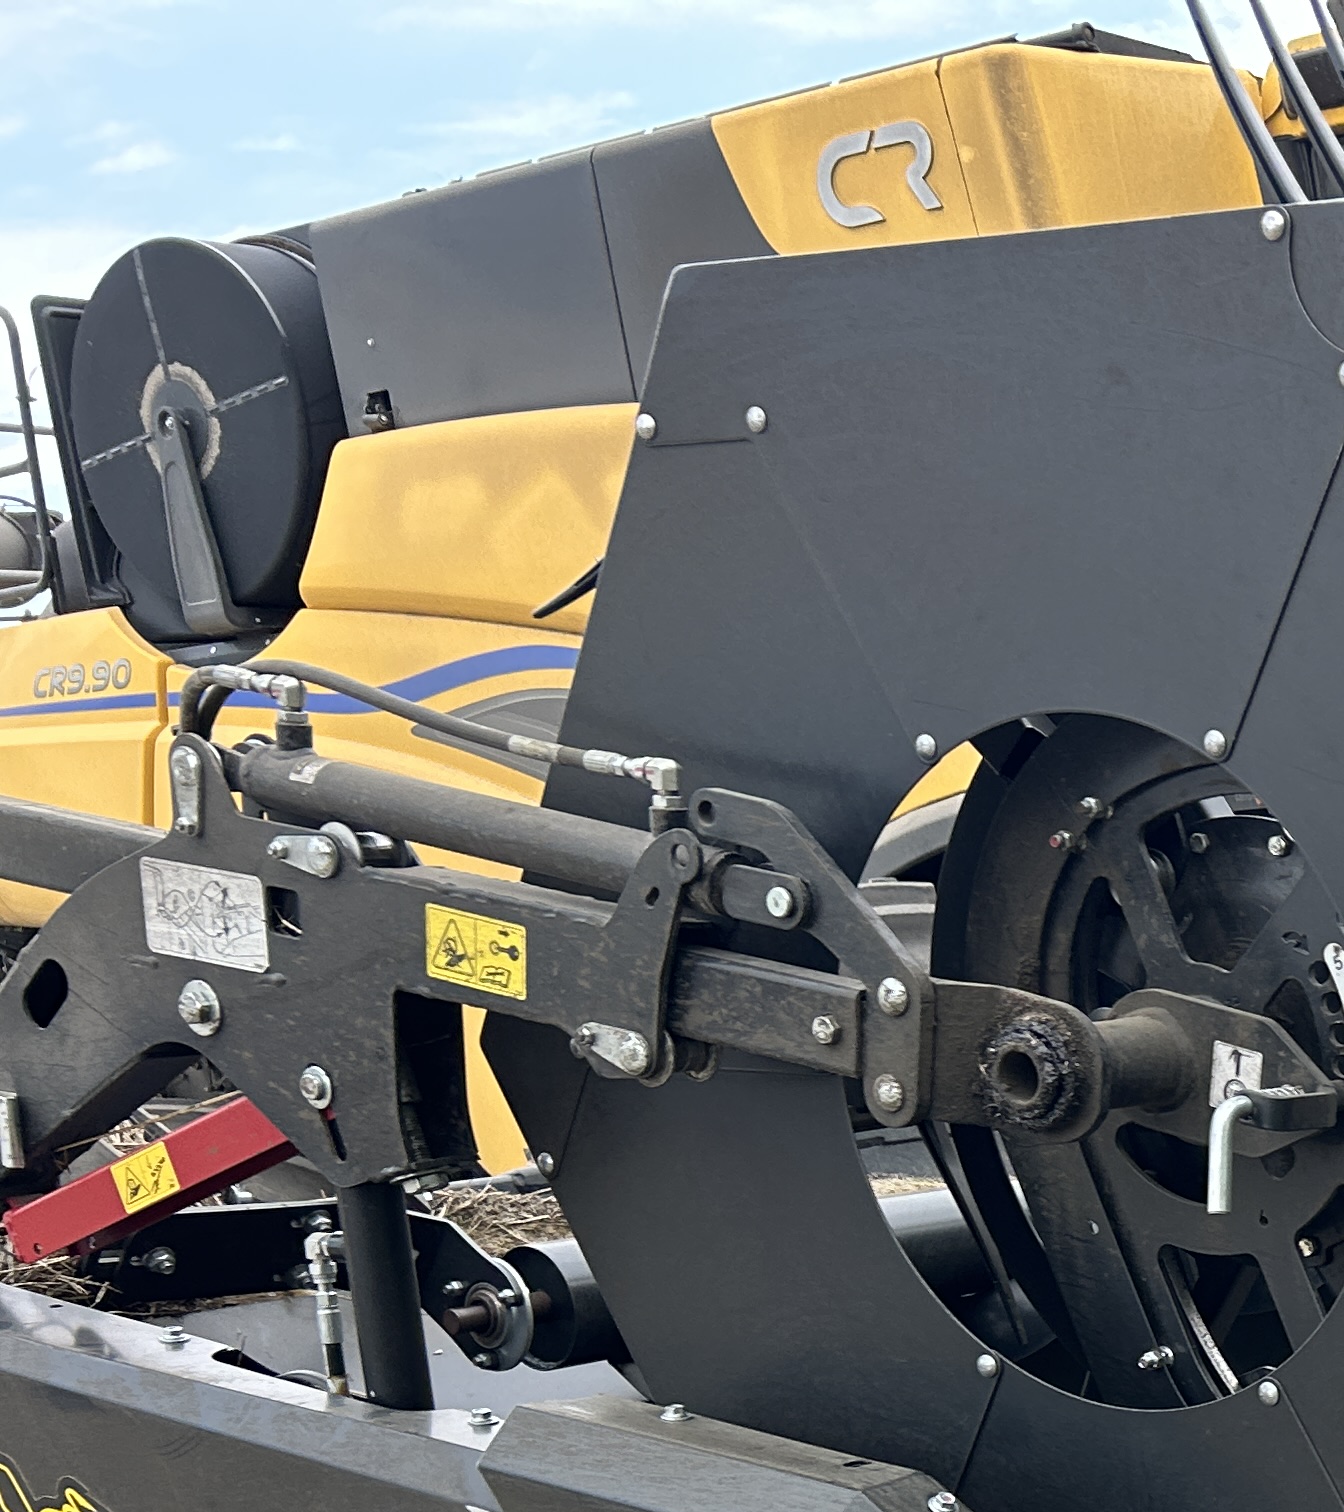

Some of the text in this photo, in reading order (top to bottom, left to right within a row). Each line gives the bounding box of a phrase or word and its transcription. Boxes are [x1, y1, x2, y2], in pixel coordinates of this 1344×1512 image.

[817, 120, 943, 228] CR
[33, 658, 132, 698] CR9.90
[1333, 954, 1343, 971] 5
